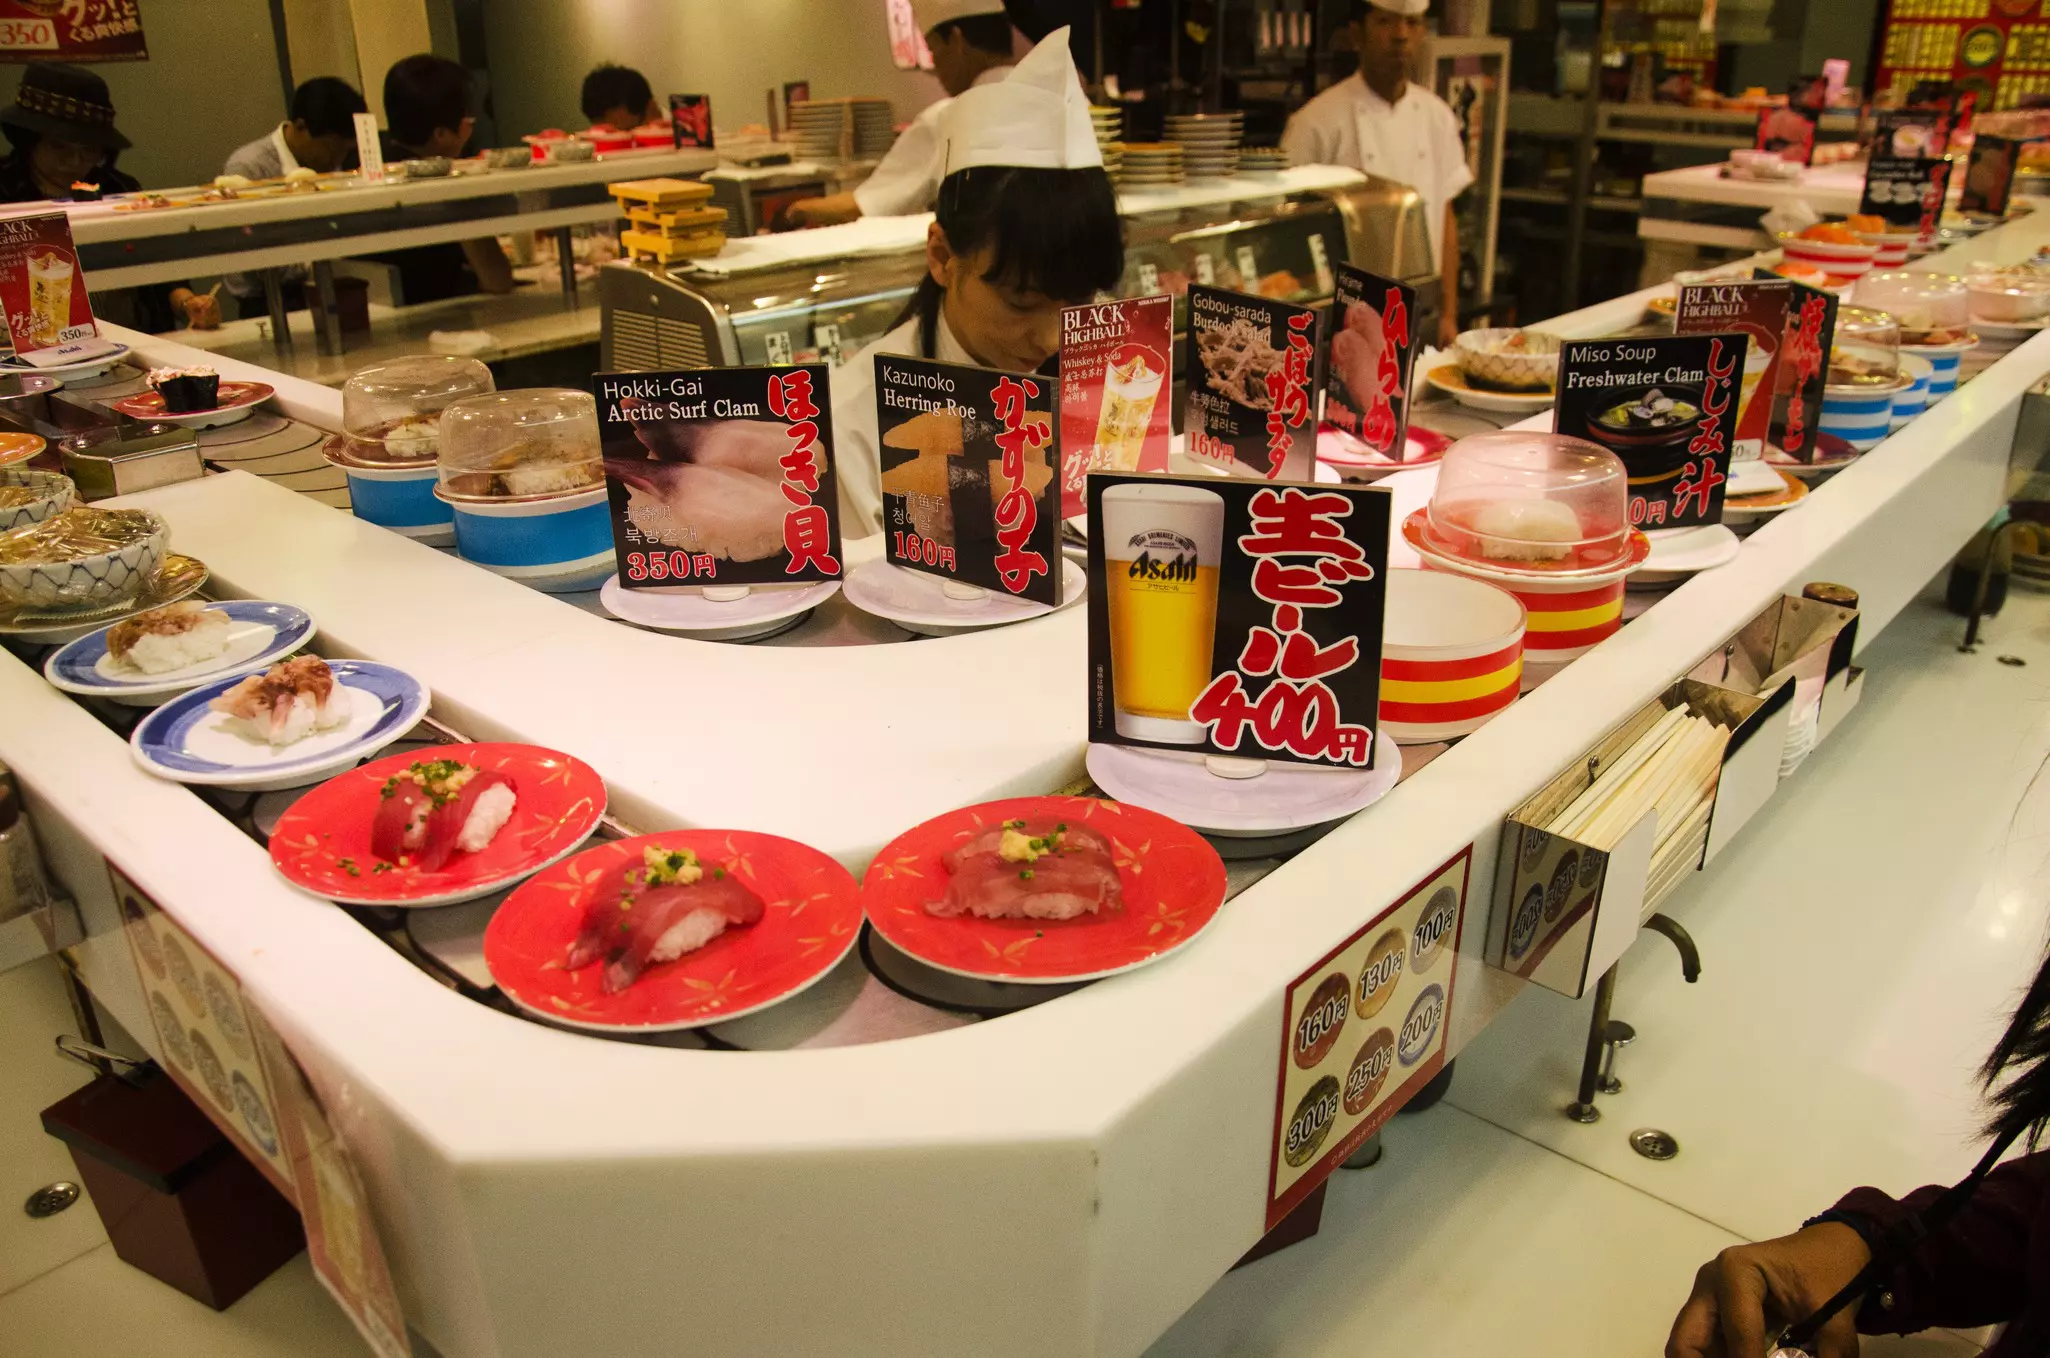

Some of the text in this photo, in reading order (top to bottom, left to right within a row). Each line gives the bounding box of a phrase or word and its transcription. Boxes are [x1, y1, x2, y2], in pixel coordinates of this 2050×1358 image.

[0, 22, 52, 45] 350
[1192, 293, 1272, 325] Gobou-sarada
[1684, 285, 1744, 305] BLACK
[1063, 303, 1126, 332] BLACK
[1064, 323, 1125, 346] HIGHBALL
[1063, 351, 1122, 369] Whiskey & Soda
[1570, 344, 1657, 367] Miso Soup
[603, 378, 703, 399] Hokki-Gai
[883, 365, 955, 393] Kazunoko
[1566, 366, 1705, 390] Freshwater Clam
[607, 398, 760, 422] Arctic Surf Clam
[883, 387, 977, 420] Herring Roe
[1672, 337, 1738, 518] しじみ汁
[1190, 431, 1235, 466] 160円
[1629, 496, 1668, 526] 0円
[626, 550, 717, 581] 350円
[893, 530, 957, 572] 160円
[1128, 549, 1198, 583] Asahi
[1237, 487, 1375, 683] 生ビール
[1187, 670, 1374, 767] 400円
[1413, 906, 1455, 958] 100円
[1359, 946, 1405, 1002] 130円
[1299, 994, 1350, 1053] 160円
[1399, 1001, 1443, 1055] 200円
[1346, 1043, 1394, 1101] 250円
[1287, 1083, 1340, 1155] 300円
